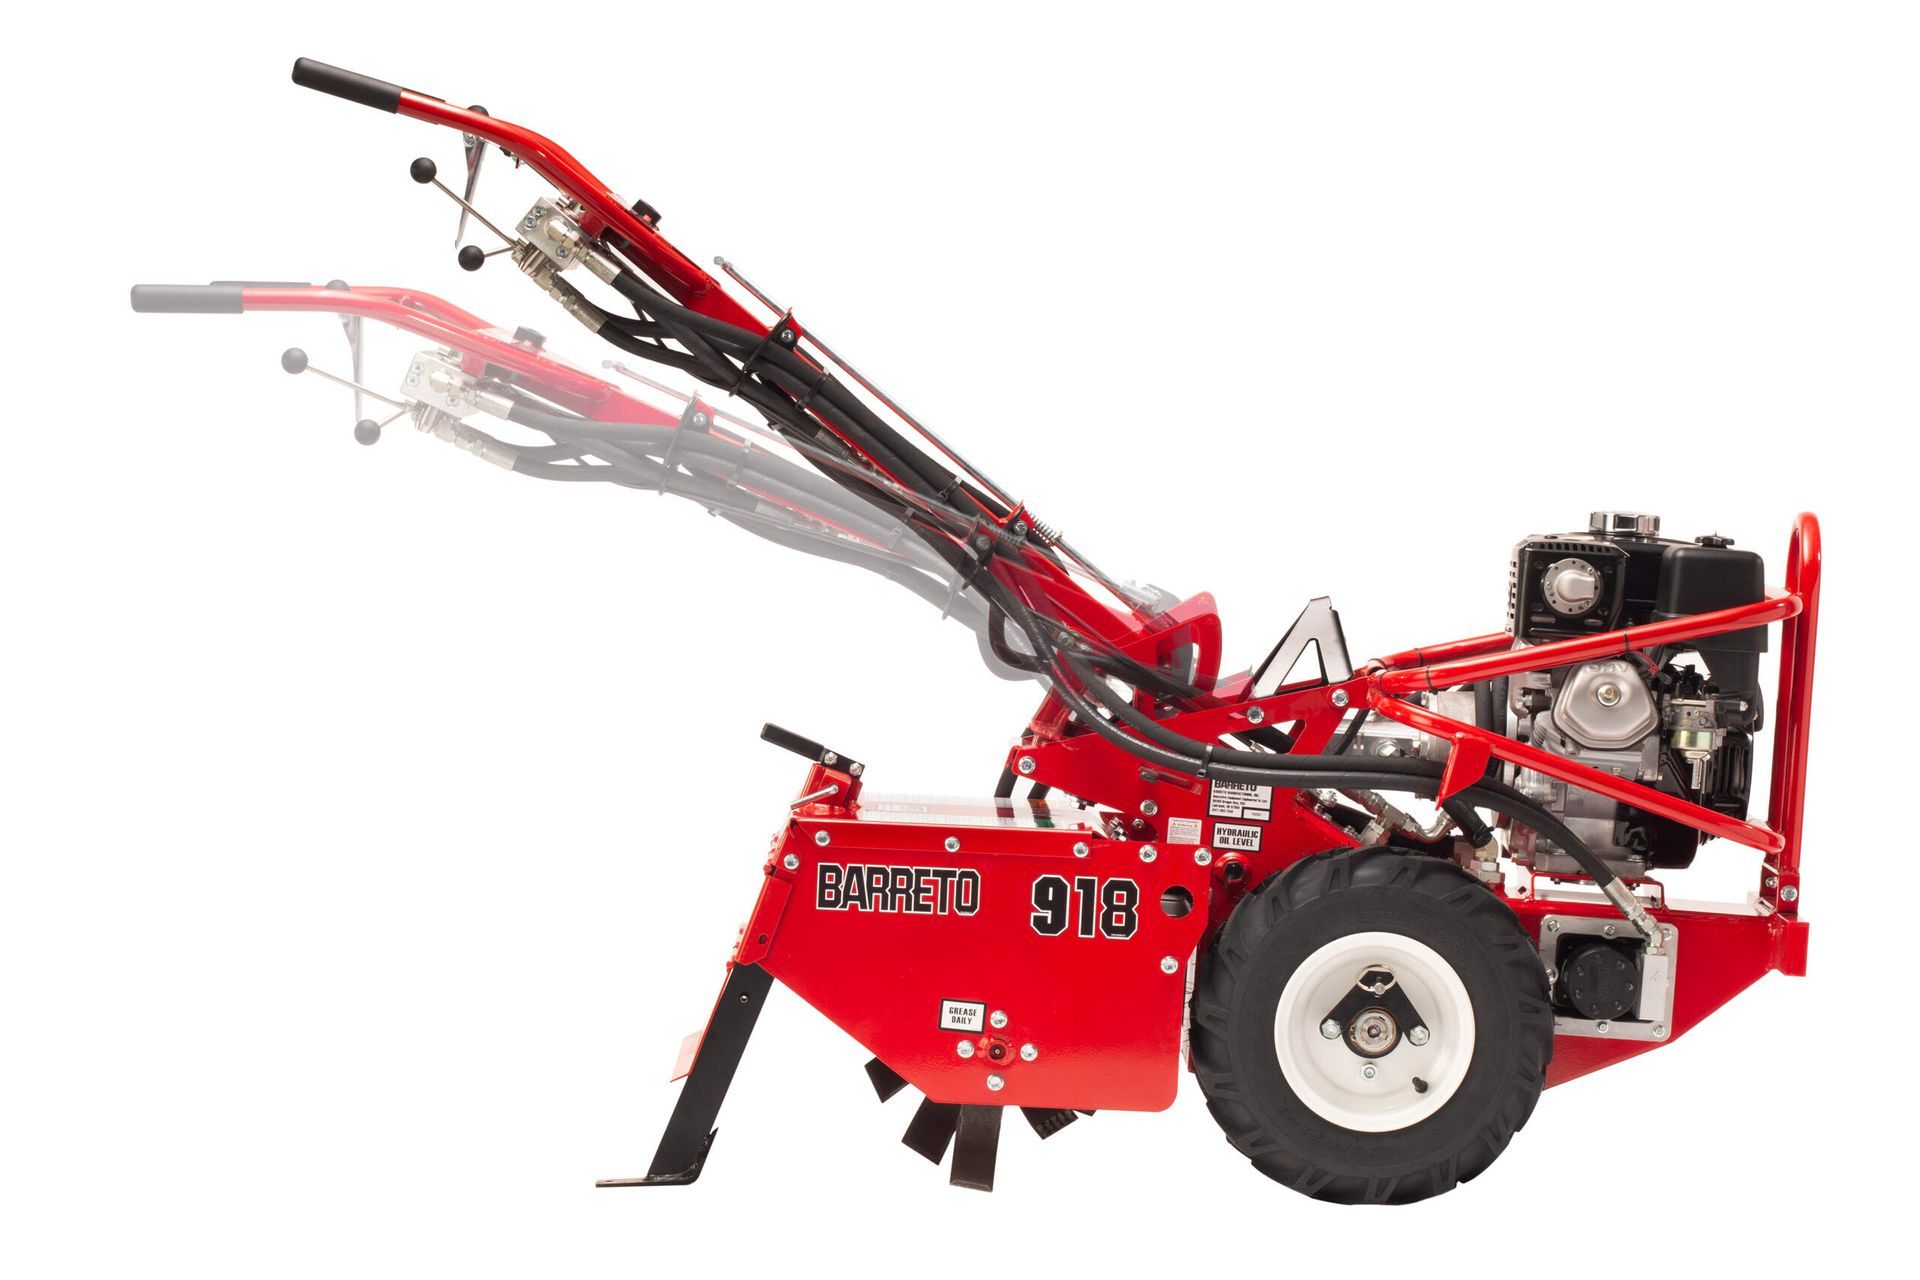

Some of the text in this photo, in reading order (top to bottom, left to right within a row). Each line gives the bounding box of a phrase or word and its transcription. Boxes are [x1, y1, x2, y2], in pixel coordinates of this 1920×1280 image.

[1216, 827, 1259, 839] HYDRAULIC
[1219, 836, 1254, 847] OIL LEVEL
[816, 862, 1140, 940] BARRETO 918
[949, 1006, 977, 1017] GREASE
[951, 1015, 972, 1025] DAILY
